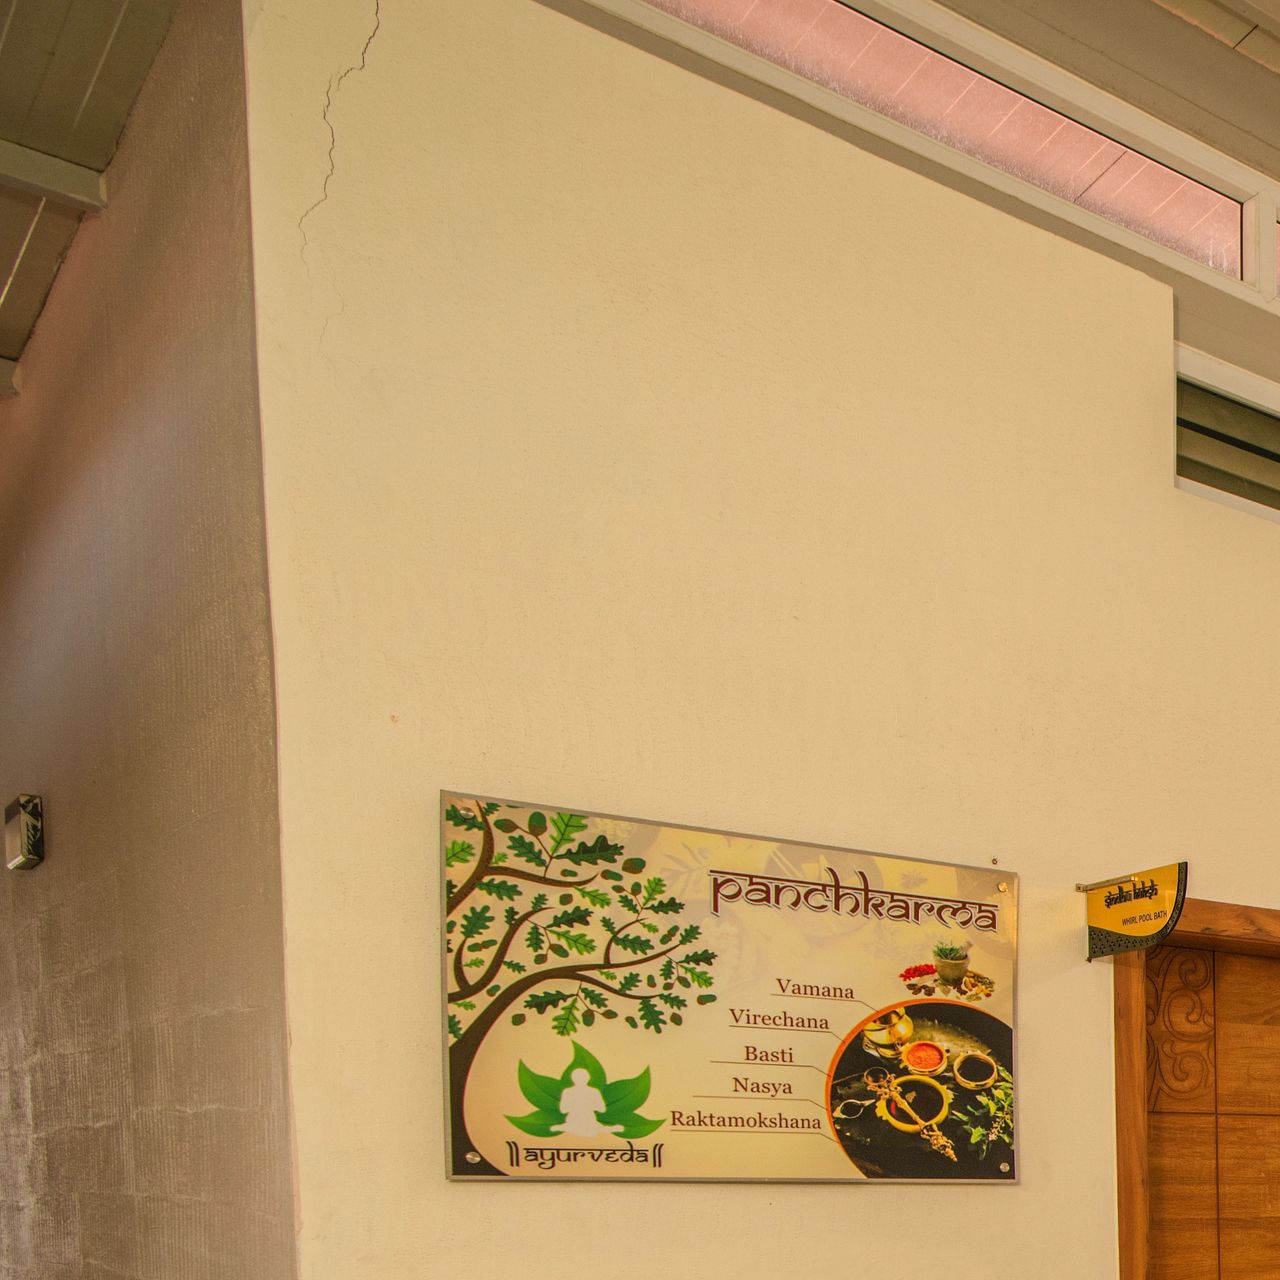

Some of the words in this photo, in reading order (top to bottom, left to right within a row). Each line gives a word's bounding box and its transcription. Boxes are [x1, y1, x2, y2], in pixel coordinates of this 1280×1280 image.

[709, 866, 998, 932] panchkarma
[1121, 915, 1138, 926] WHIRL
[1138, 913, 1153, 923] POOL
[1153, 910, 1168, 920] BATH
[776, 978, 855, 999] Vamana
[729, 1008, 829, 1029] Virechana
[744, 1045, 794, 1063] Basti
[732, 1077, 792, 1097] Nasya
[670, 1110, 822, 1129] Raktamokshana
